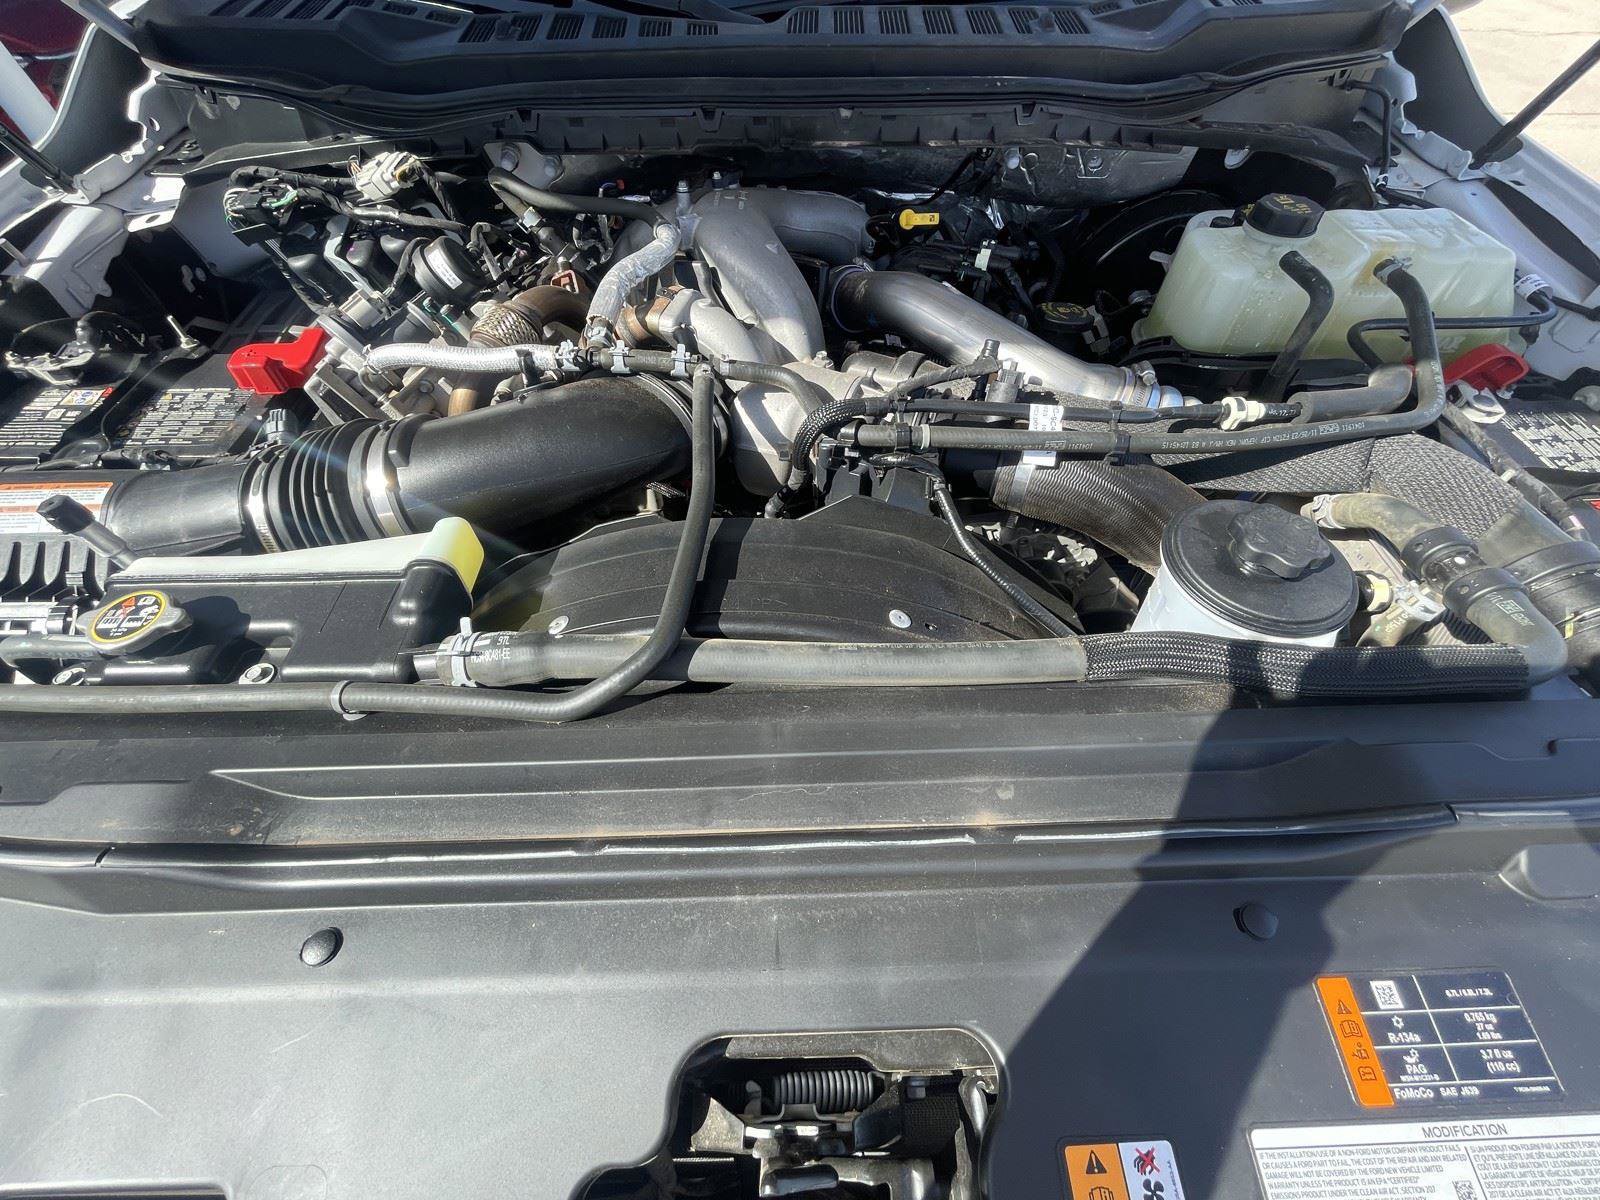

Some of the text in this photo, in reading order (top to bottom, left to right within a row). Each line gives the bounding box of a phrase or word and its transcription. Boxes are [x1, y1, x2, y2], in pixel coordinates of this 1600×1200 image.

[1387, 1032, 1422, 1044] R-134a
[1480, 1049, 1494, 1059] 3.7
[1406, 1063, 1428, 1075] PAG
[1487, 1061, 1521, 1073] (110 cc)
[1393, 1087, 1435, 1099] FoMoCo
[1439, 1087, 1458, 1097] SAE
[1421, 1123, 1508, 1138] MODIFICATION
[1371, 1147, 1391, 1155] MOTOR
[1391, 1146, 1418, 1155] COMPANY
[1418, 1144, 1445, 1153] PRODUCT
[1430, 1154, 1442, 1162] ANY
[1441, 1153, 1468, 1162] RELATED
[1369, 1167, 1384, 1175] FORD
[1384, 1166, 1399, 1174] NEW
[1398, 1165, 1422, 1174] VEHICLE
[1333, 1178, 1360, 1187] PRODUCT
[1359, 1187, 1378, 1196] CLEAN
